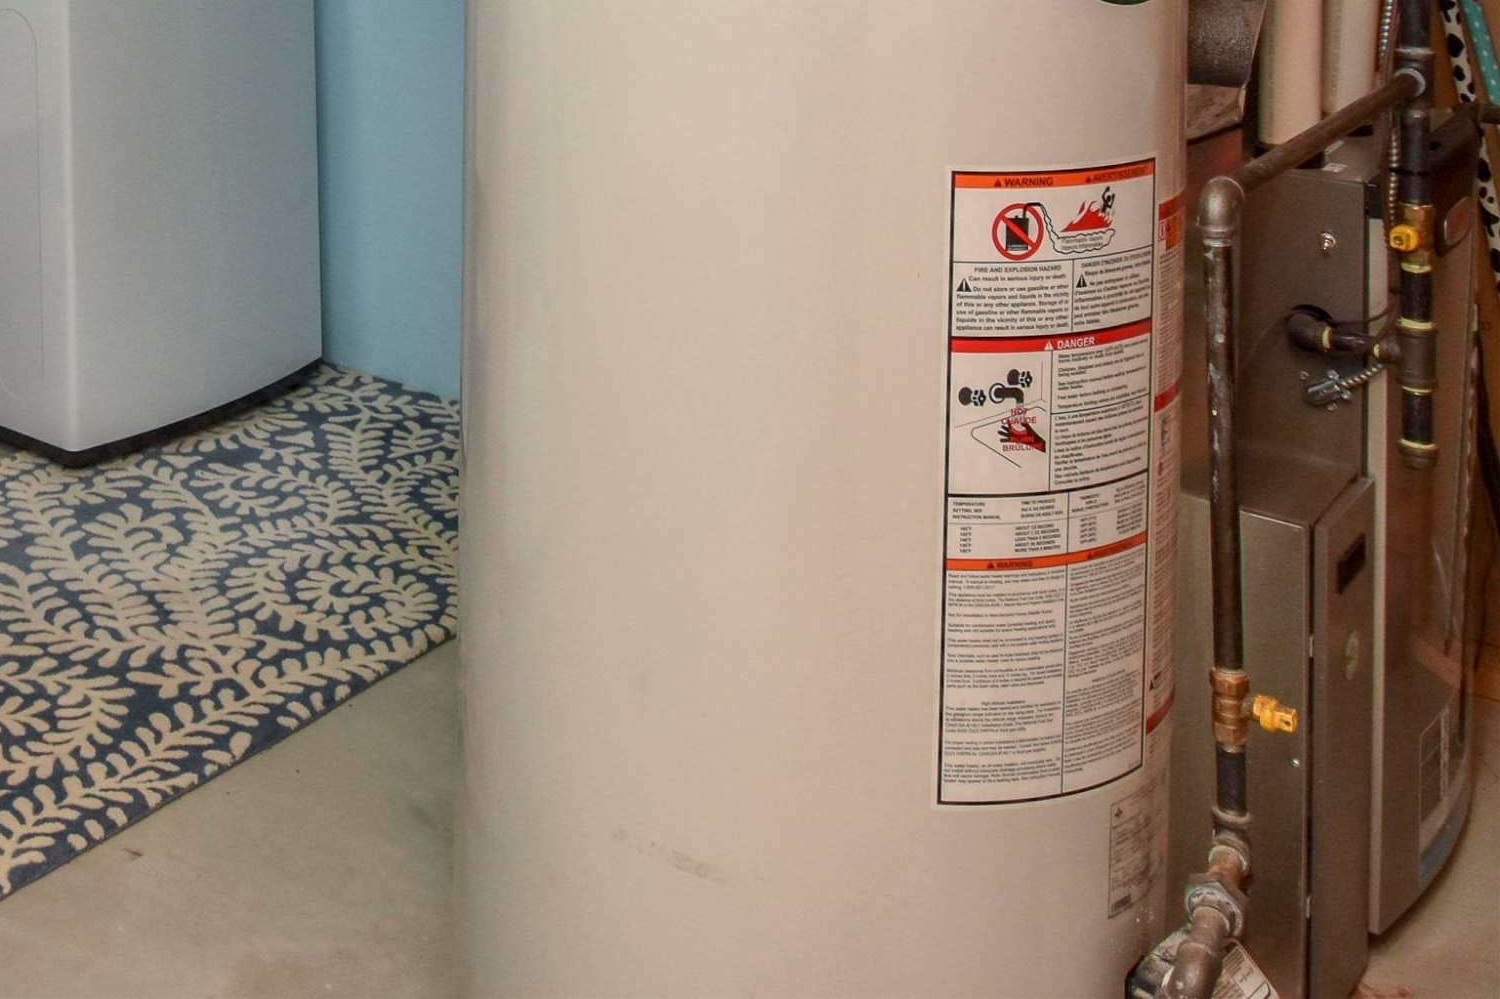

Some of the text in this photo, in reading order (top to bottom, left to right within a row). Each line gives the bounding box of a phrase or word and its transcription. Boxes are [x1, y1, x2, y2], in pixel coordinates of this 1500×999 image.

[1005, 177, 1053, 187] WARNING
[1057, 337, 1095, 349] DANGER
[1010, 408, 1027, 416] HOT
[1002, 442, 1041, 452] BRULU
